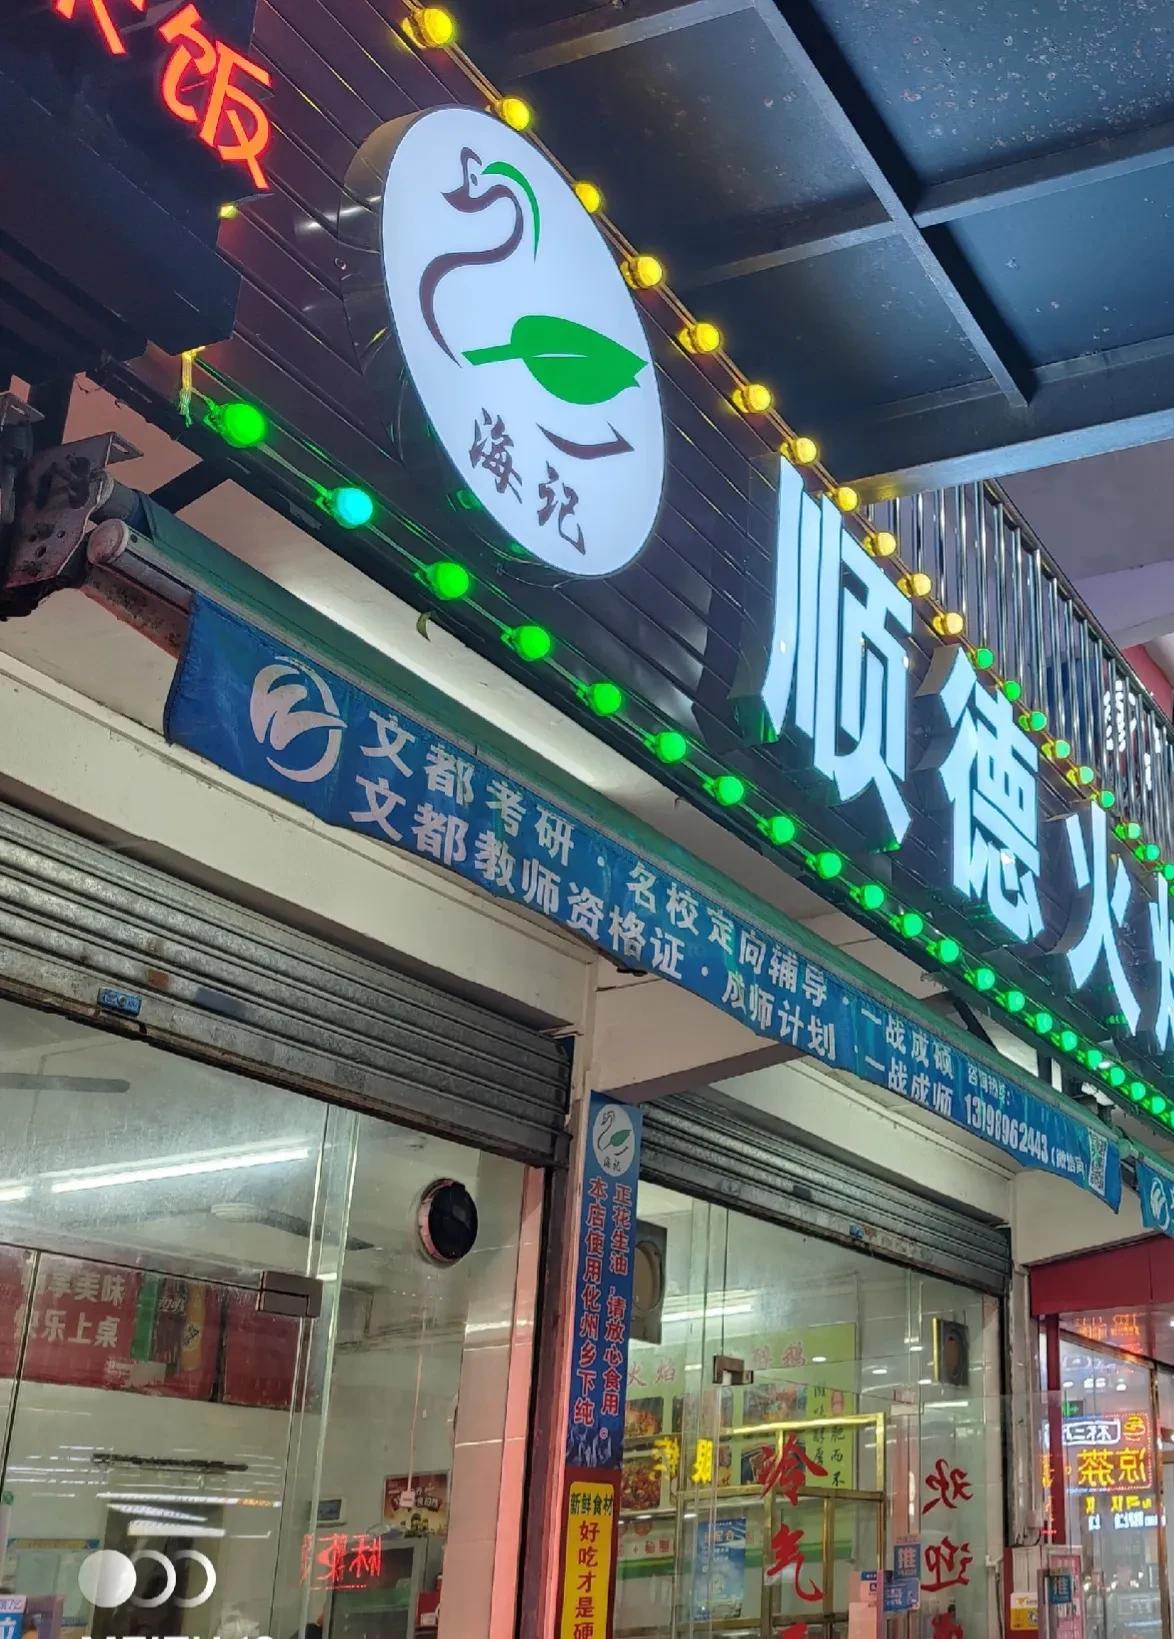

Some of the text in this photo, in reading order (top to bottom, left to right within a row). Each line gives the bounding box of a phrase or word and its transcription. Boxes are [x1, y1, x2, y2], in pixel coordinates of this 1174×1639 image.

[468, 407, 587, 556] 海记
[573, 1177, 609, 1427] 本店使用化州乡下纯
[570, 1492, 614, 1517] 新鲜食材
